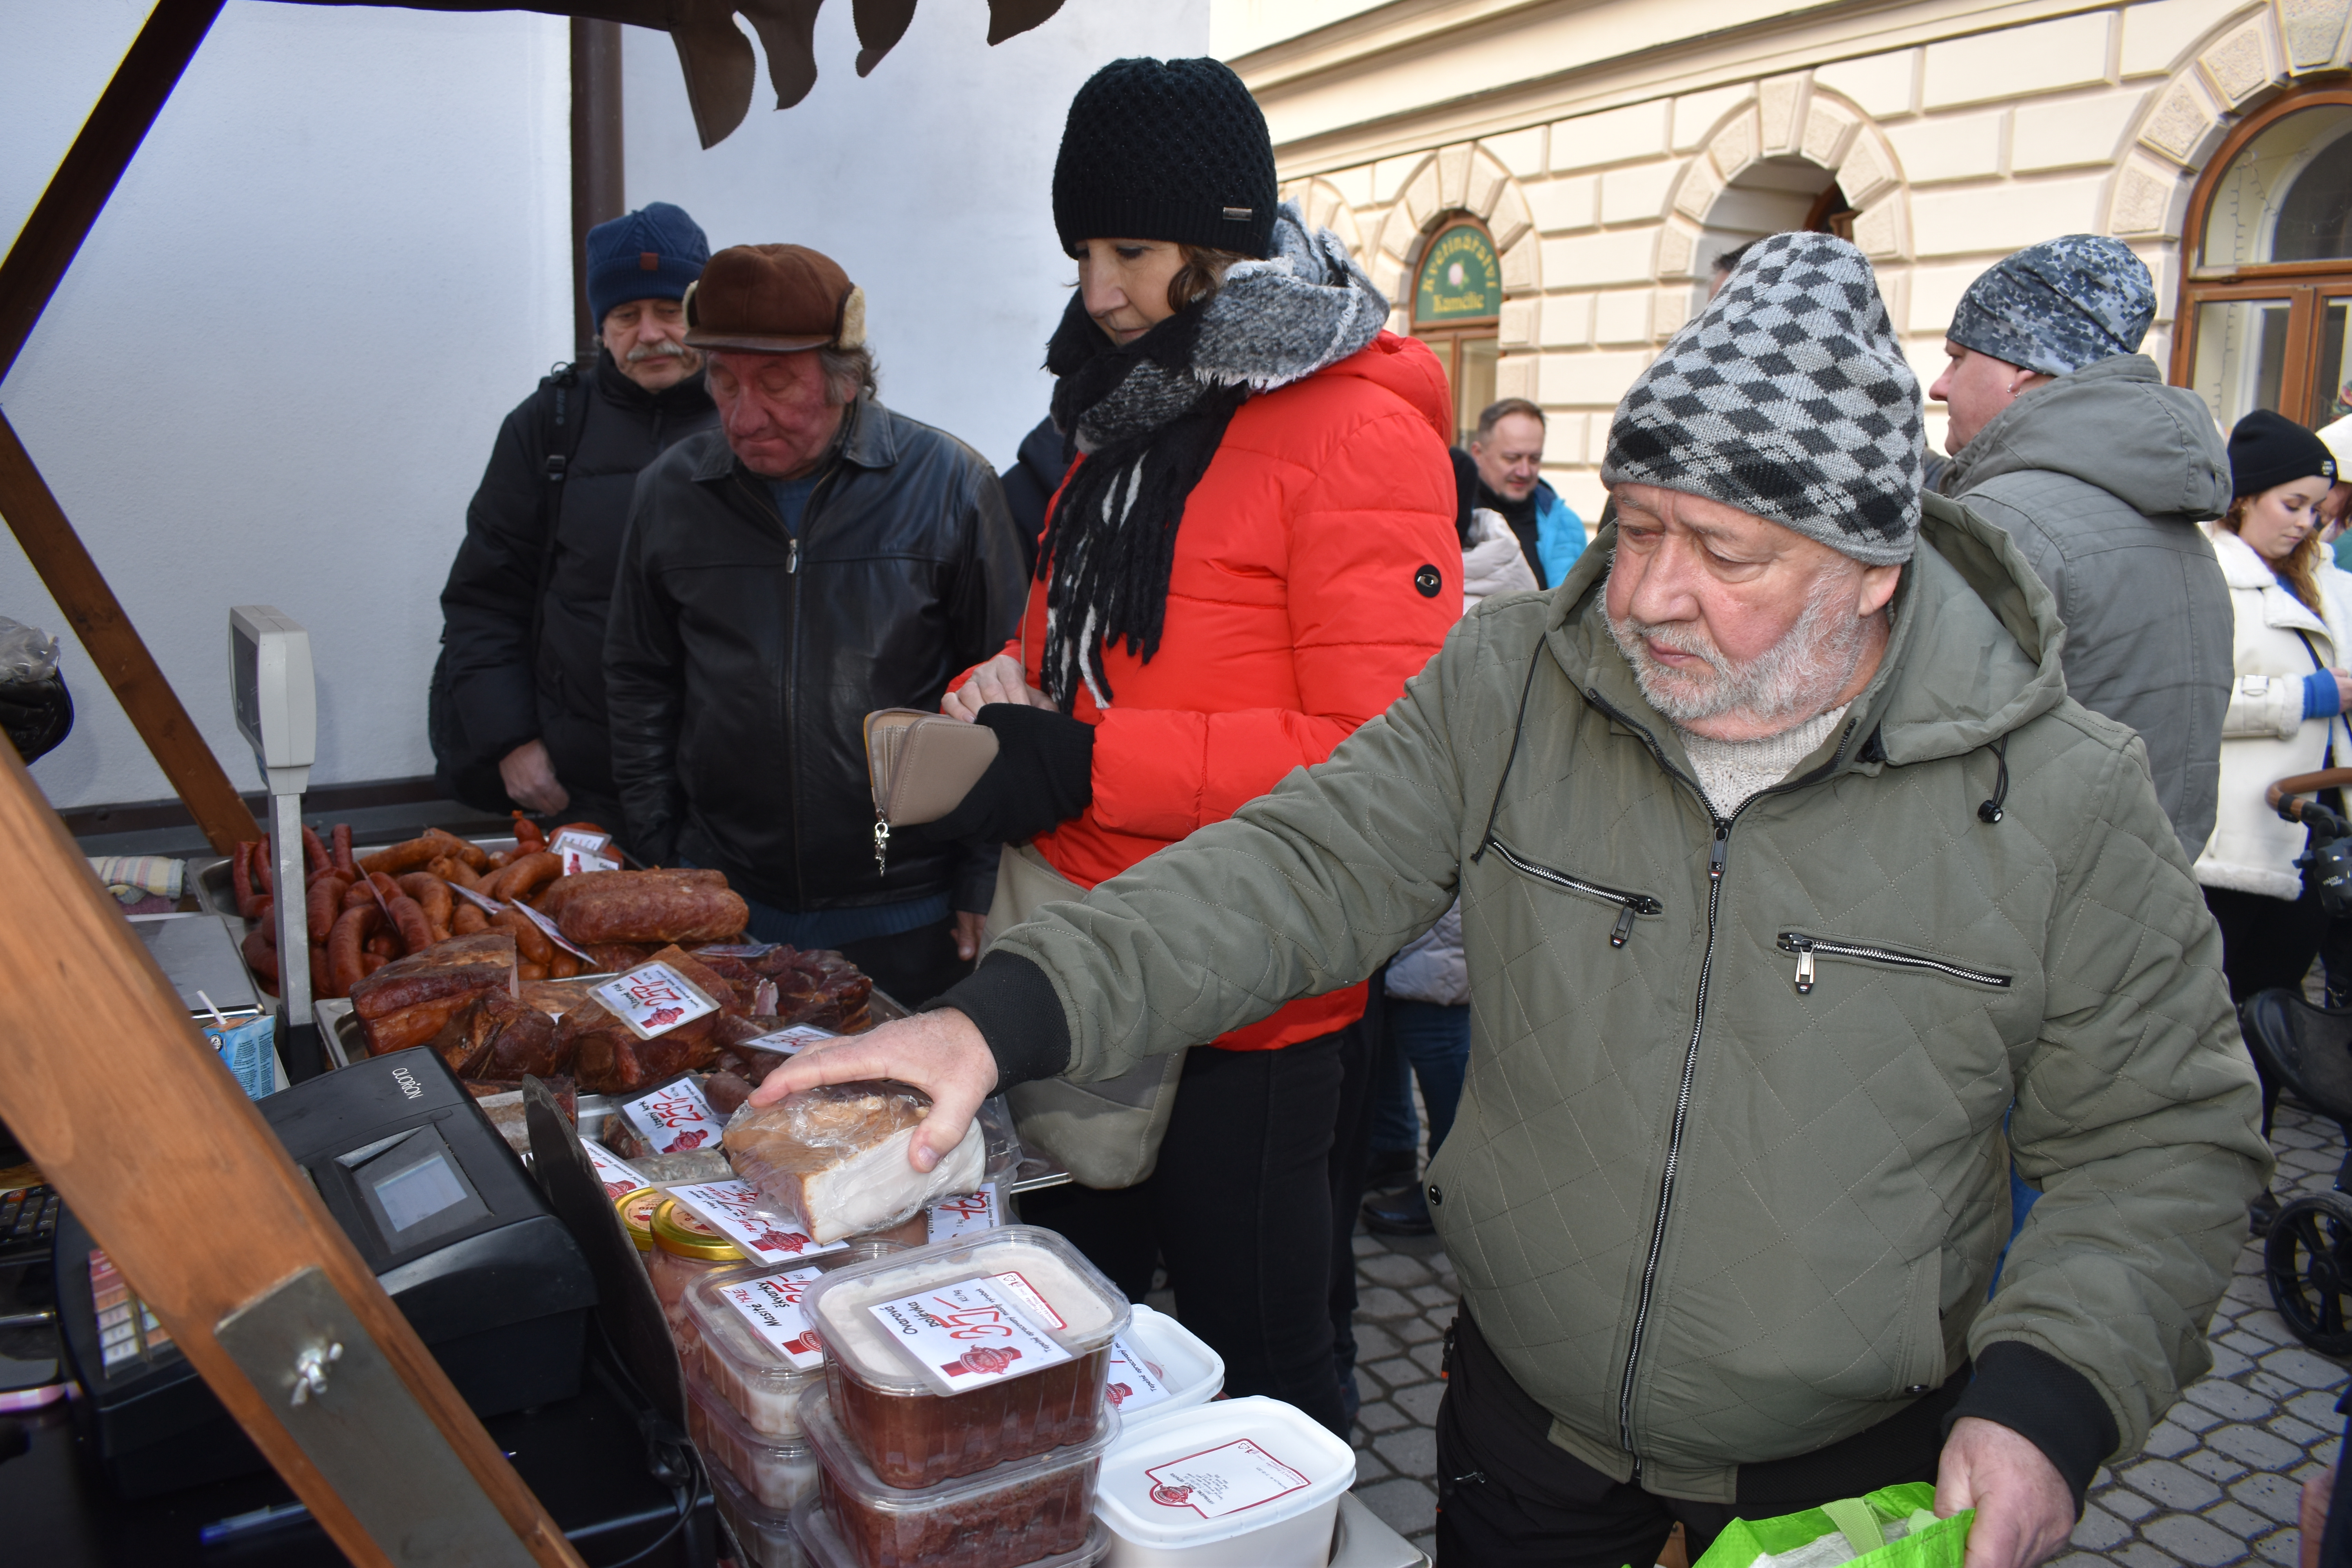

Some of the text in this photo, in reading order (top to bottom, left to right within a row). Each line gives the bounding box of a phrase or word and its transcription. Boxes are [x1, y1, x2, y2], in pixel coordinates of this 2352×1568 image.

[639, 1101, 651, 1112] krk
[723, 1289, 753, 1303] MALÉ
[756, 1282, 790, 1308] škvarky
[953, 1290, 969, 1301] Kč/kg
[975, 1289, 995, 1303] výrobek
[746, 1304, 782, 1326] Masité
[884, 1306, 918, 1334] Ovarová
[908, 1301, 944, 1327] polévka
[1005, 1317, 1034, 1336] opracovaný
[1031, 1337, 1051, 1352] Tepelně
[1117, 1349, 1156, 1392] Tepelně opracovaný
